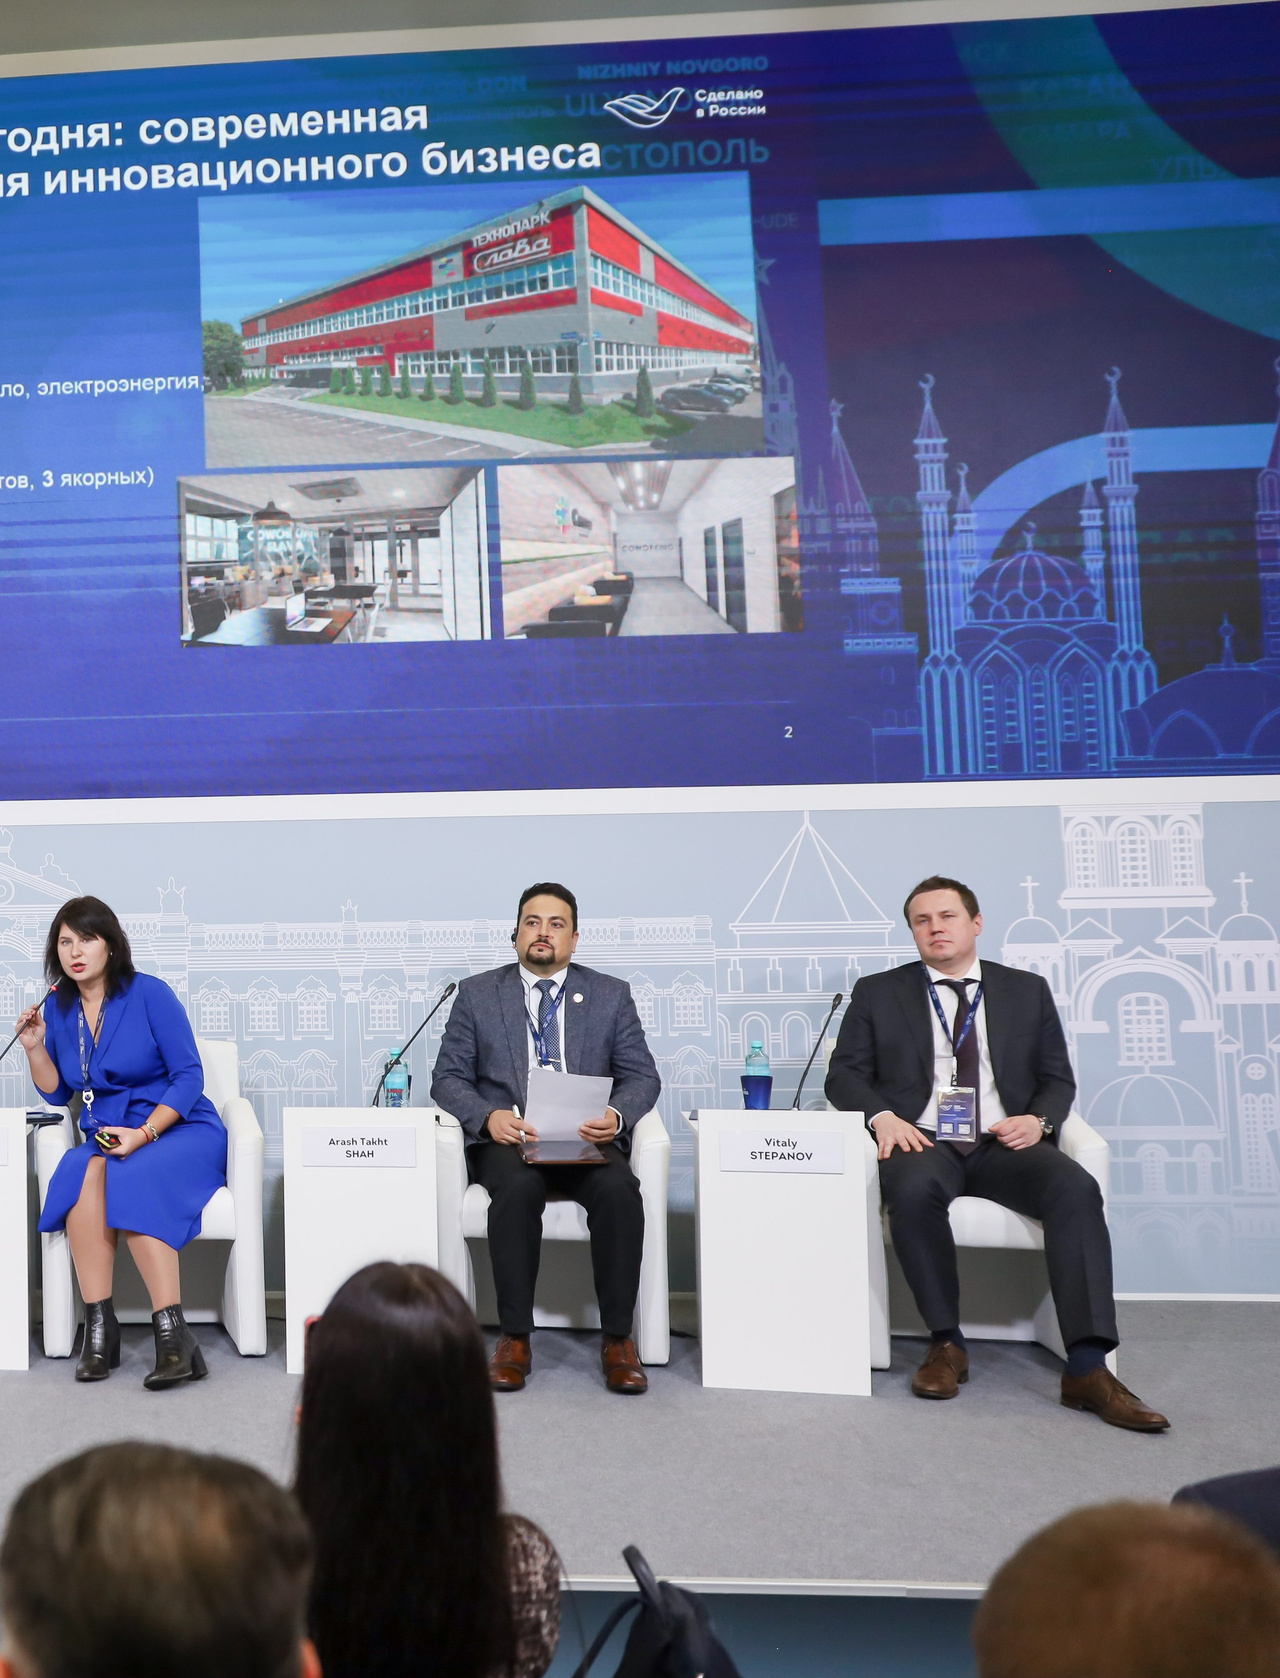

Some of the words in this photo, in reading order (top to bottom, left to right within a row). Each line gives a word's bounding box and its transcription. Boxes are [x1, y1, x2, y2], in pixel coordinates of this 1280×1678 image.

[695, 88, 764, 103] Сделано
[696, 108, 705, 118] в
[709, 105, 767, 118] России
[138, 104, 429, 149] современная
[43, 151, 408, 196] инновационного
[421, 141, 602, 176] бизнеса
[472, 209, 551, 248] ТЕХНОПАРК
[37, 375, 207, 398] электроэнергия,
[42, 469, 55, 488] 3
[60, 465, 155, 490] якорных)
[784, 725, 794, 739] 2
[328, 1137, 358, 1146] Arash
[359, 1137, 389, 1146] Takht
[764, 1137, 798, 1150] Vitaly
[345, 1149, 375, 1159] SHAH
[750, 1150, 814, 1162] STEPANOV
